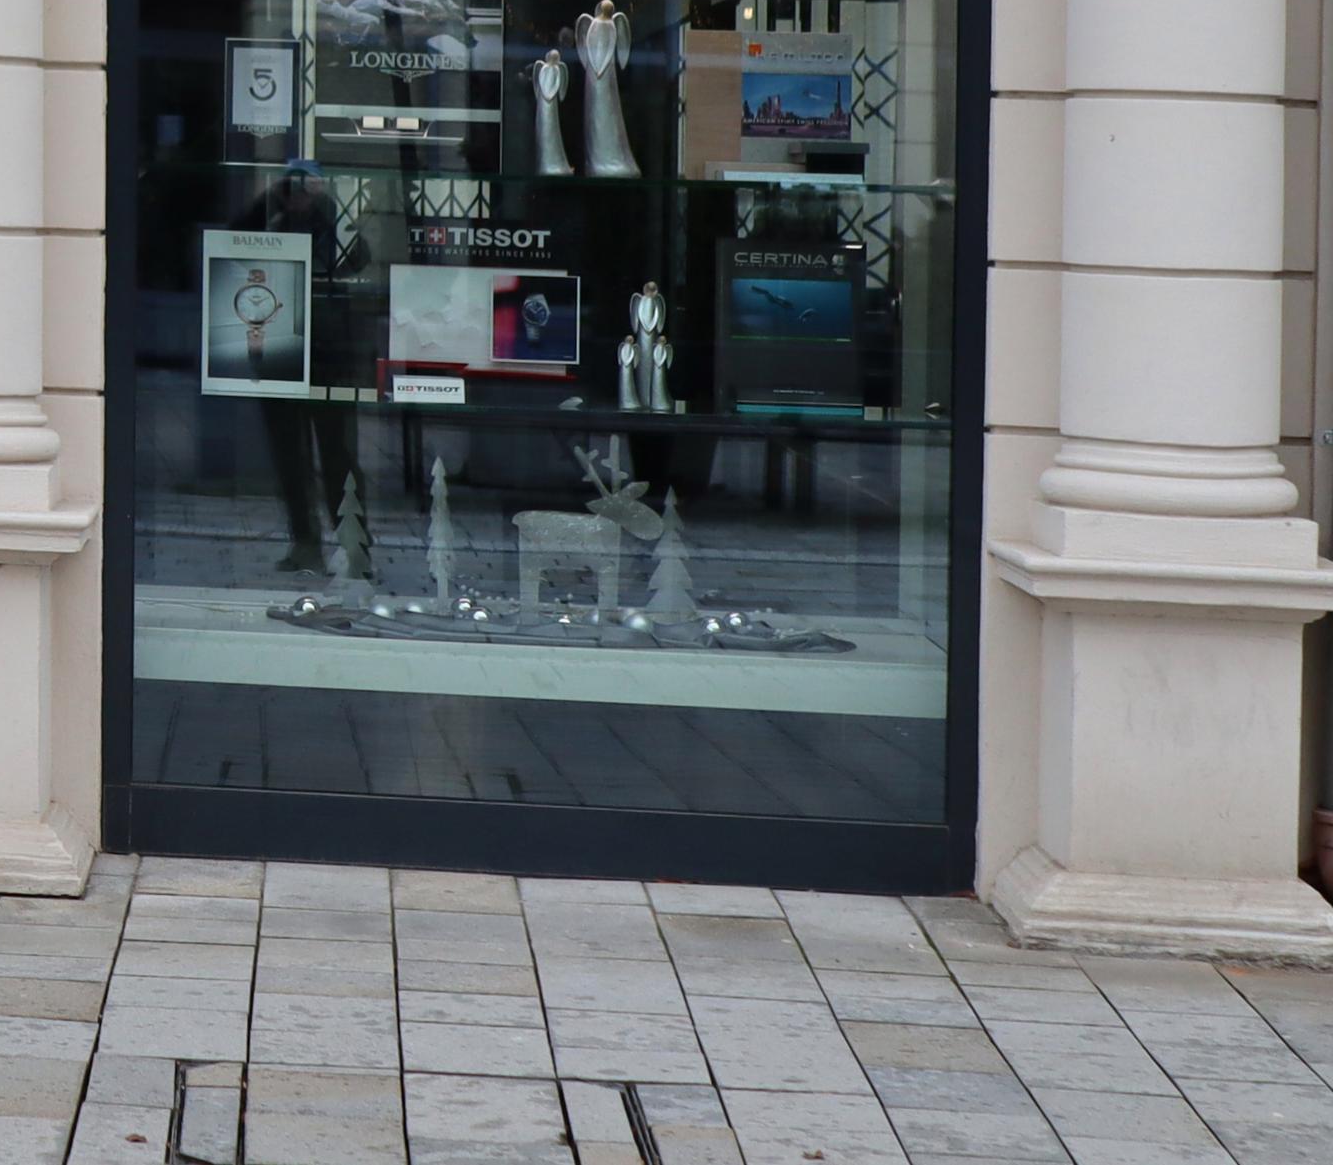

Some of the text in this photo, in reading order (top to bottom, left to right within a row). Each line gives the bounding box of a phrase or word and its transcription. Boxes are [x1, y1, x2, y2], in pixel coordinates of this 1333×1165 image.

[349, 50, 467, 71] LONGINES
[249, 68, 277, 102] 5
[233, 235, 283, 247] BALMAIN
[448, 227, 551, 249] TISSOT
[495, 249, 524, 258] SINCE
[734, 251, 828, 265] CERTINA
[416, 385, 460, 393] TISSOT
